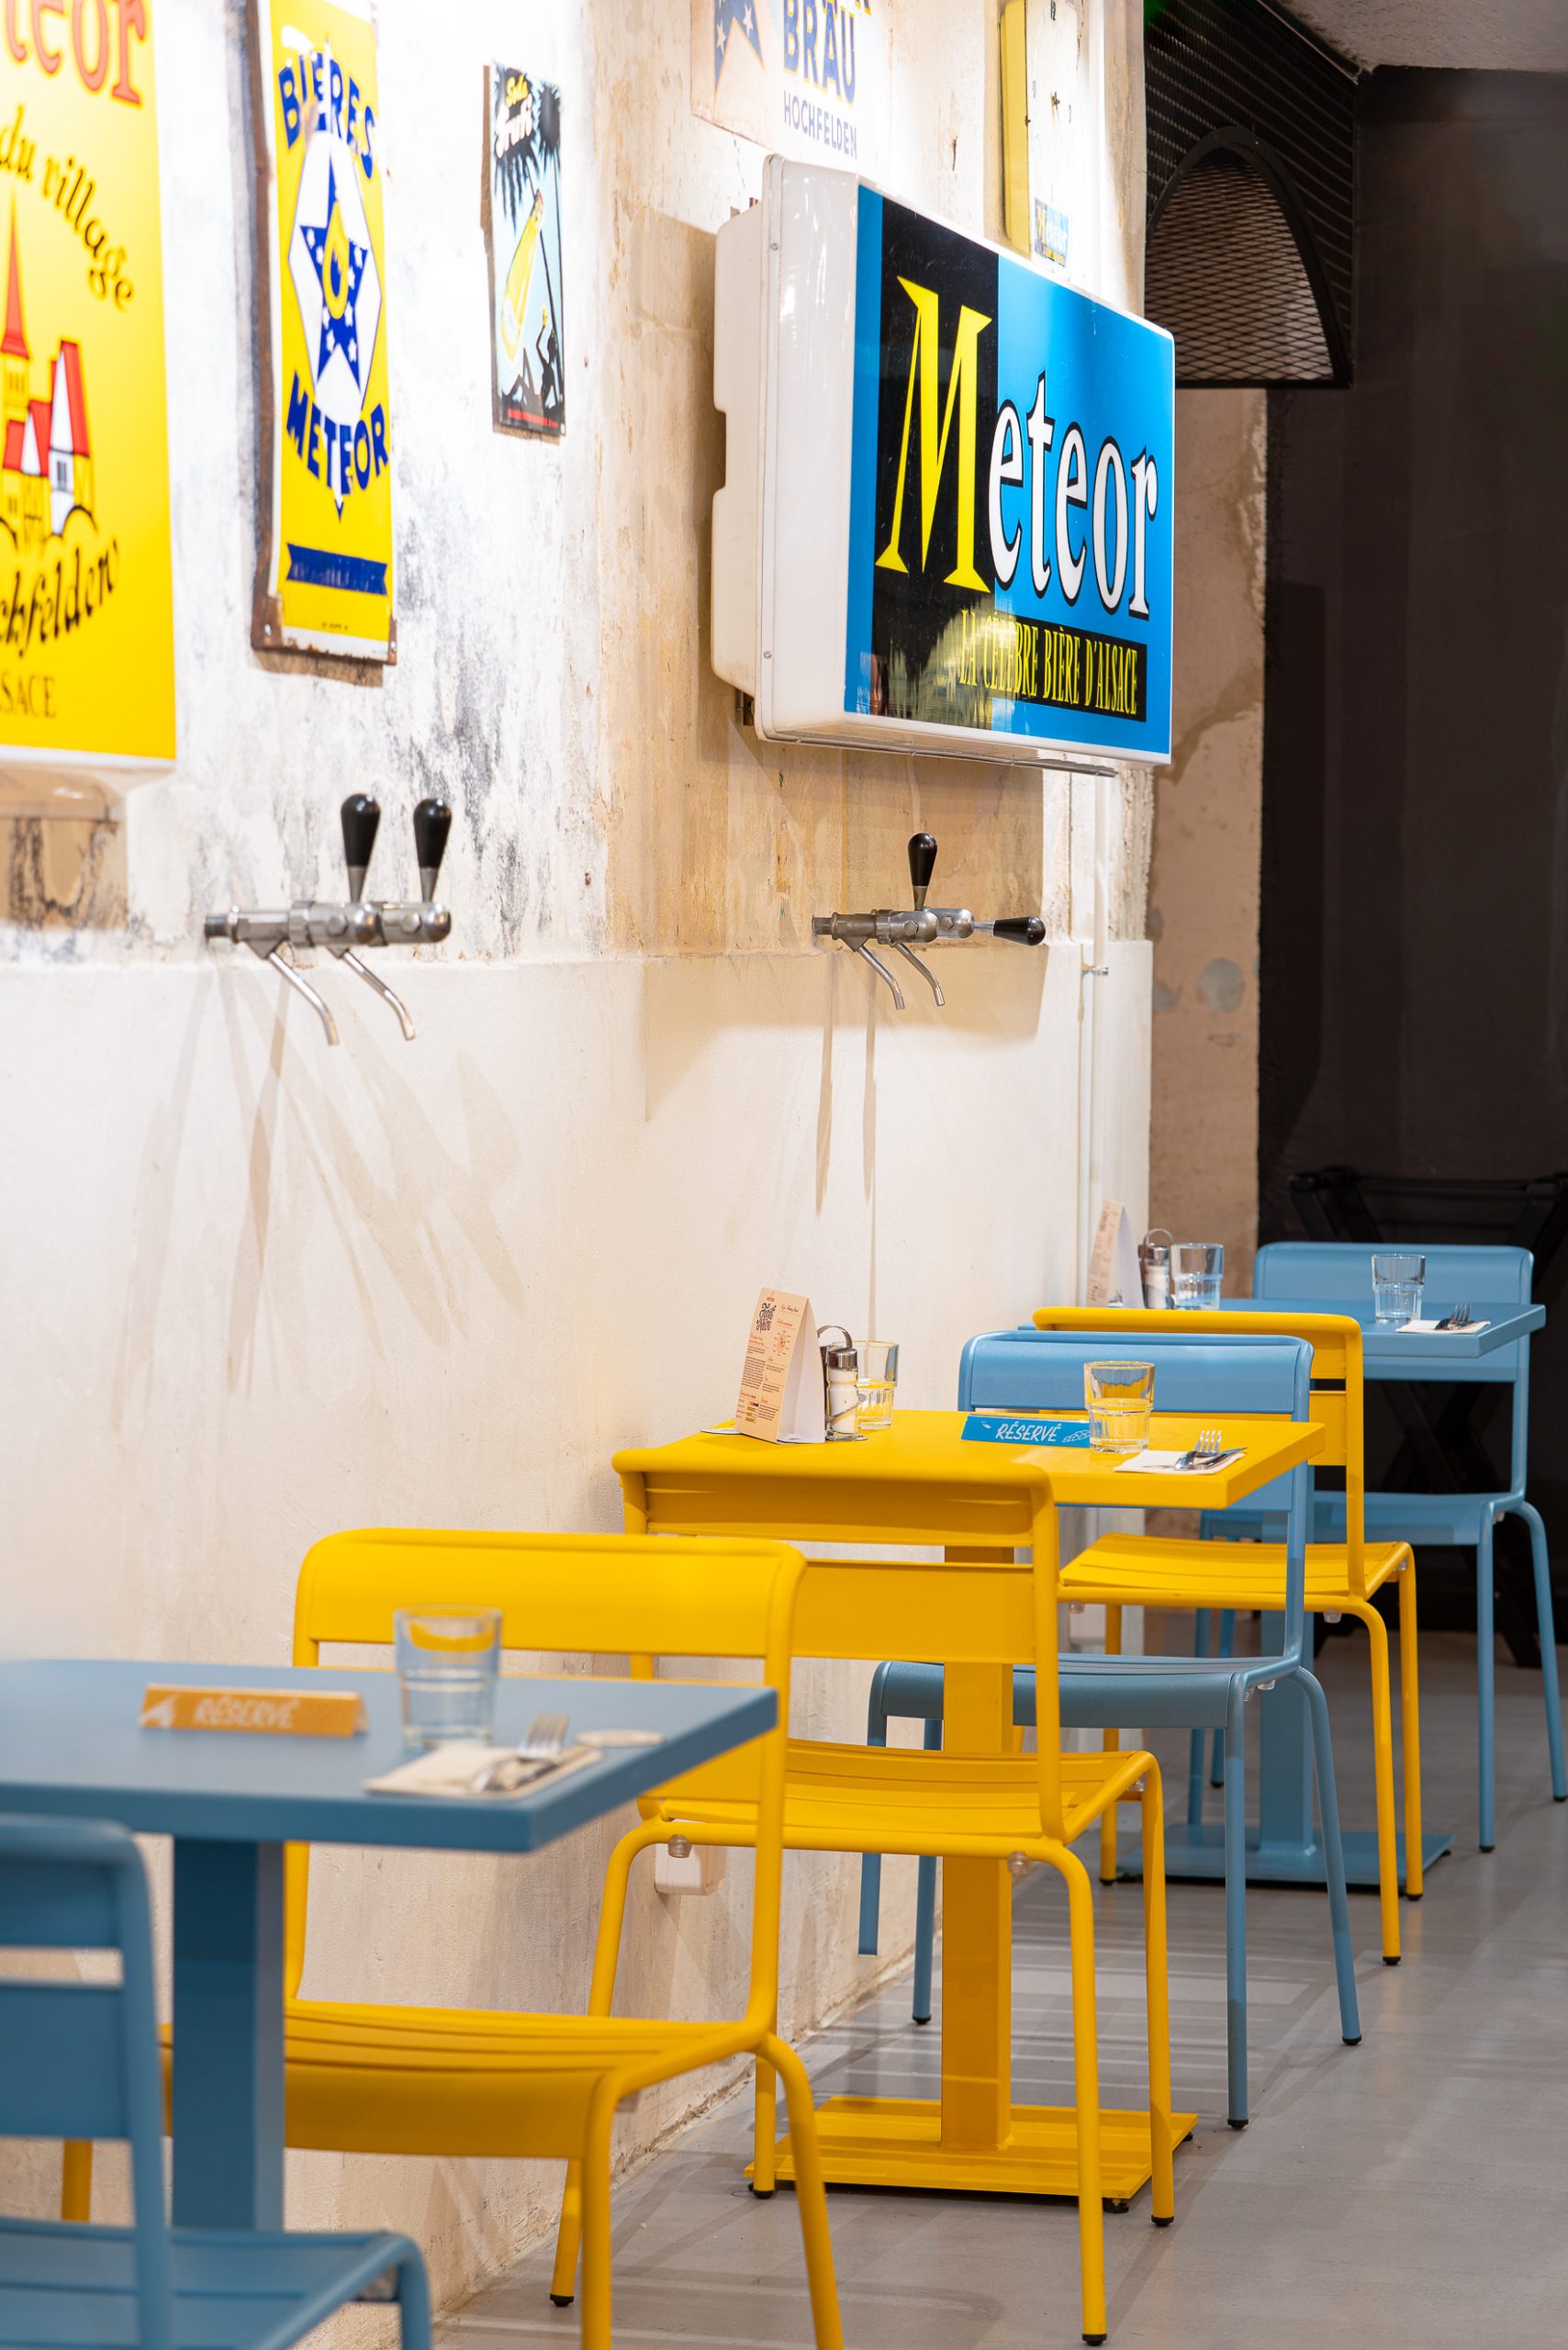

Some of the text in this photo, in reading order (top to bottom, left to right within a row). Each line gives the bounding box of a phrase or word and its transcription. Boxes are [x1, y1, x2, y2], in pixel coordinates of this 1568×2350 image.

[783, 90, 857, 159] HOCHFELDEN
[286, 370, 388, 495] METEOR
[875, 275, 1159, 620] Meteor
[958, 610, 1137, 715] LA CÉLÈBRE BIÈRE D'ALSACE
[995, 1420, 1062, 1442] RÉSERVÉ
